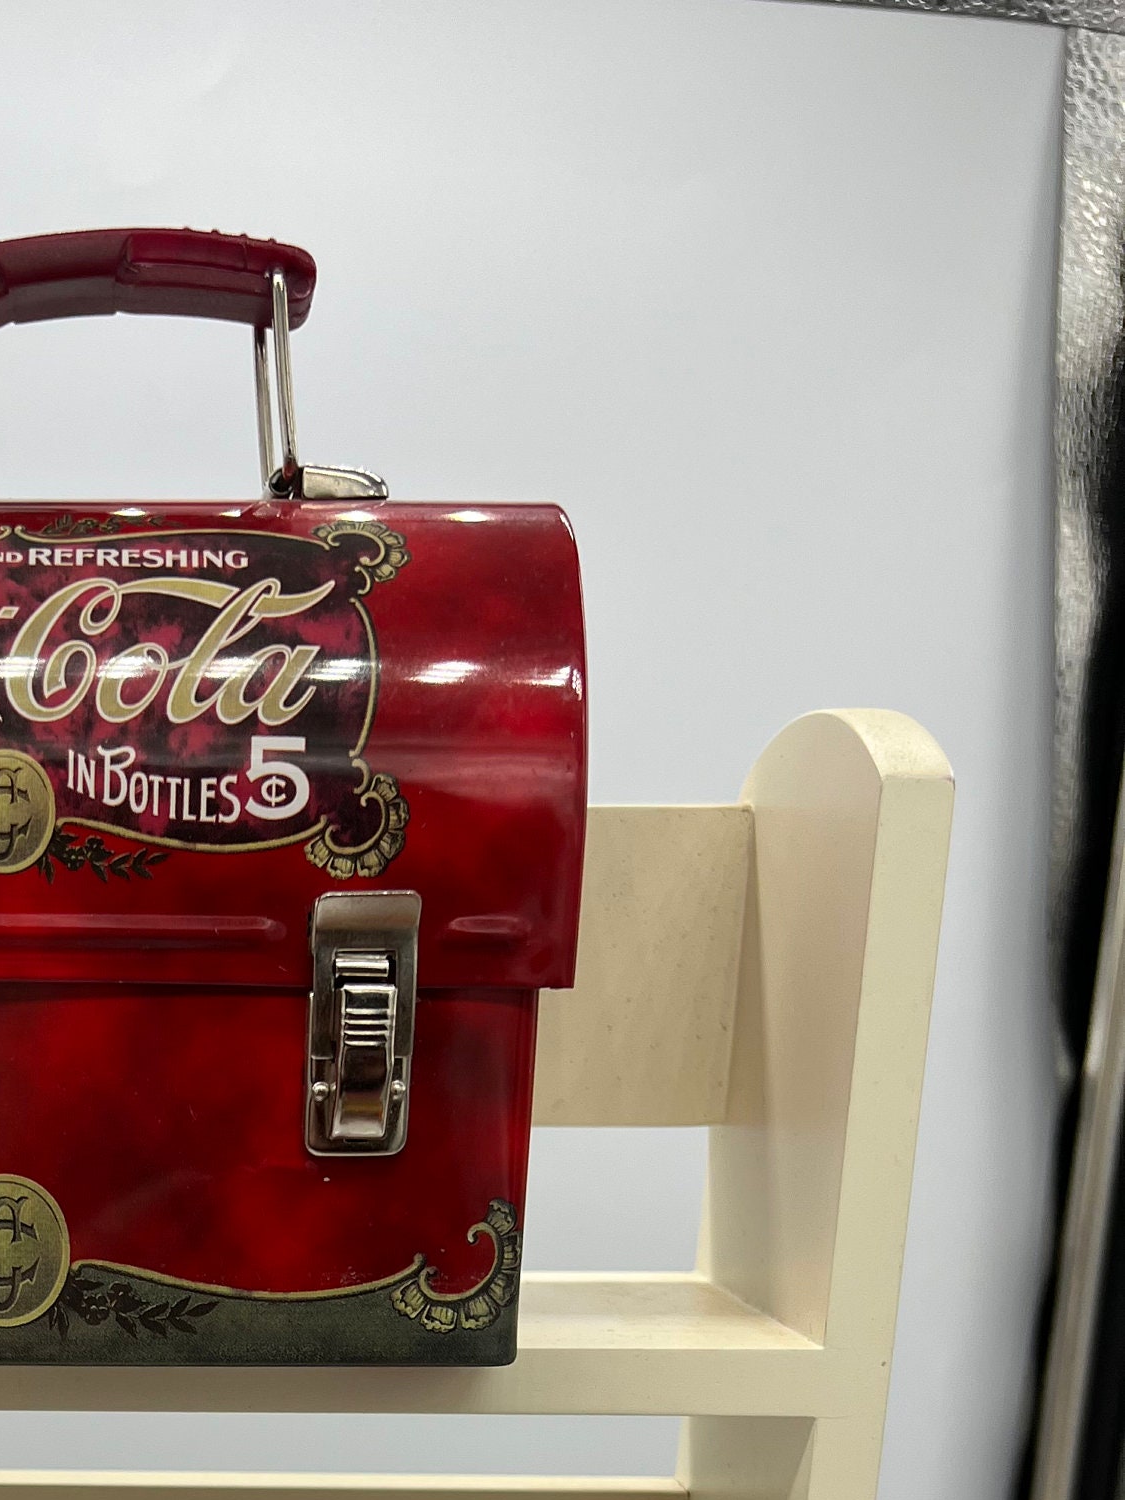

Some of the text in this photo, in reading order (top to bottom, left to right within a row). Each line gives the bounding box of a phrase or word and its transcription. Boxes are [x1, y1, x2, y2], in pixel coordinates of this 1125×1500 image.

[28, 548, 249, 569] REFRESHING
[67, 745, 241, 824] IN BOTTLES
